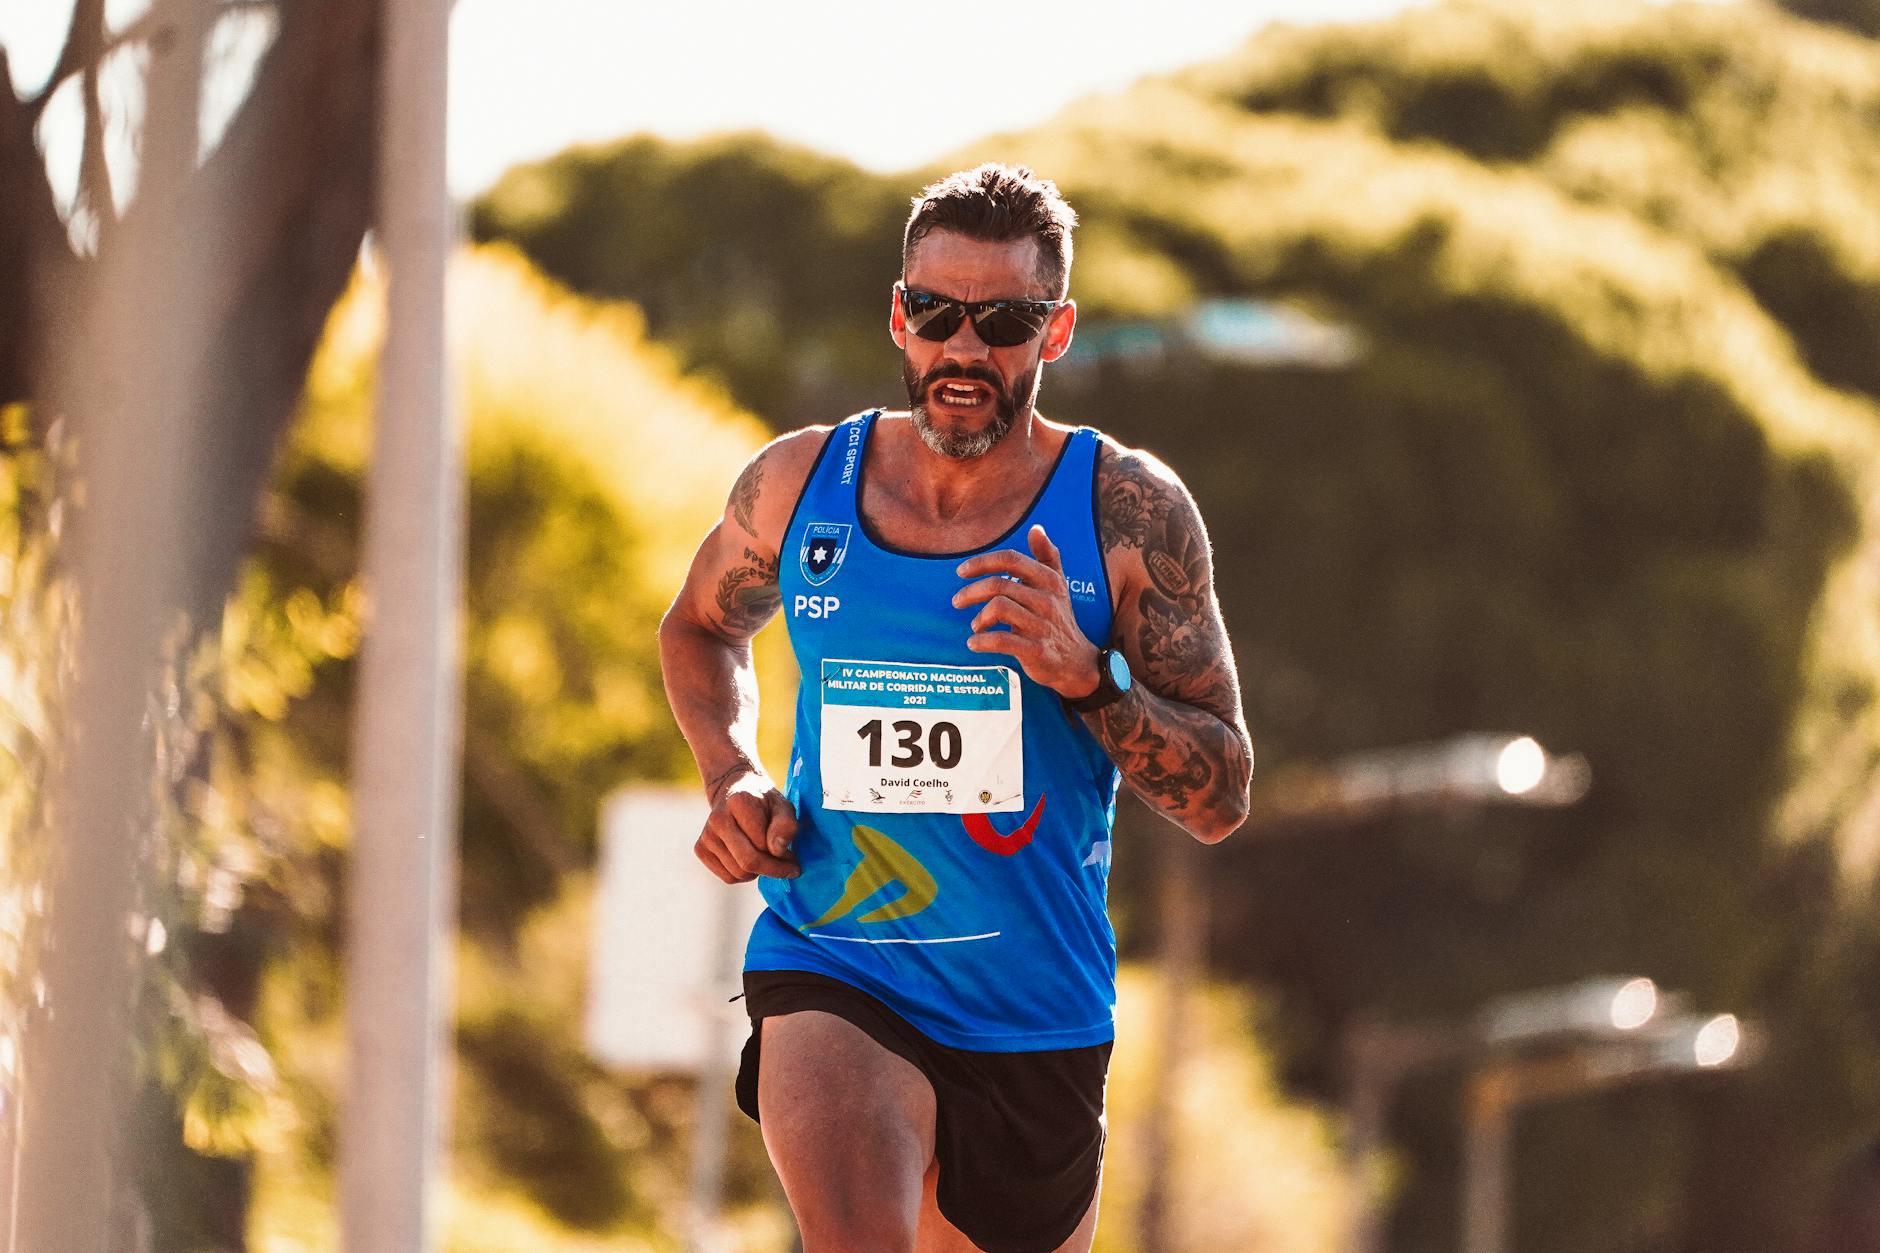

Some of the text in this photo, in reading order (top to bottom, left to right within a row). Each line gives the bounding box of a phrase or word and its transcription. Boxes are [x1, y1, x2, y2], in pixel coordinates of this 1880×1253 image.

[841, 449, 857, 485] SPORT
[813, 526, 840, 534] POLÍCIA
[1066, 576, 1096, 595] ÍCIA
[794, 595, 841, 619] PSP
[842, 668, 986, 682] IV CAMPEONATO NACIONAL
[827, 680, 1004, 694] MILITAR DE CORRIDA DE ESTRADA
[903, 696, 927, 705] 2021
[857, 720, 962, 769] 130
[880, 778, 949, 788] David Coelho
